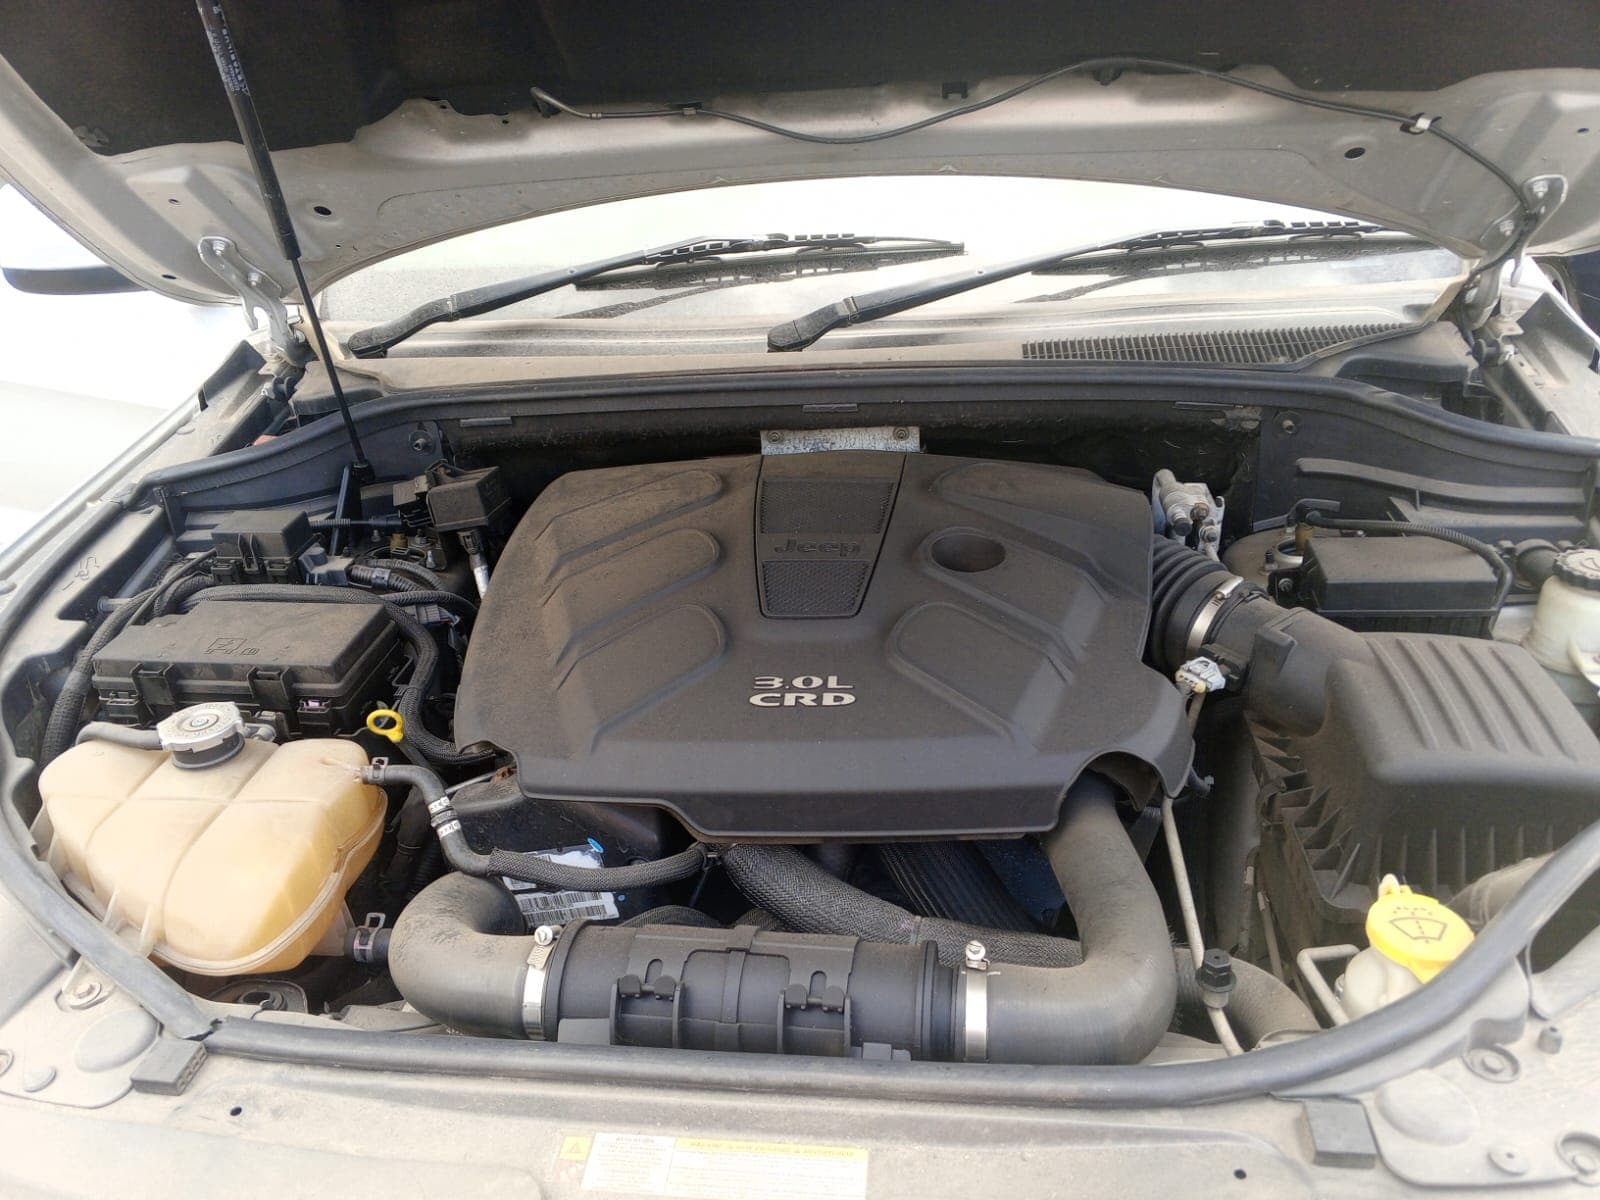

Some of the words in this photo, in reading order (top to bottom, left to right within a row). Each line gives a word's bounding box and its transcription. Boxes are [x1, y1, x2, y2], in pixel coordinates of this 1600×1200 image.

[774, 539, 860, 557] Jeep
[753, 675, 854, 689] 3.0L
[749, 692, 856, 707] CRD
